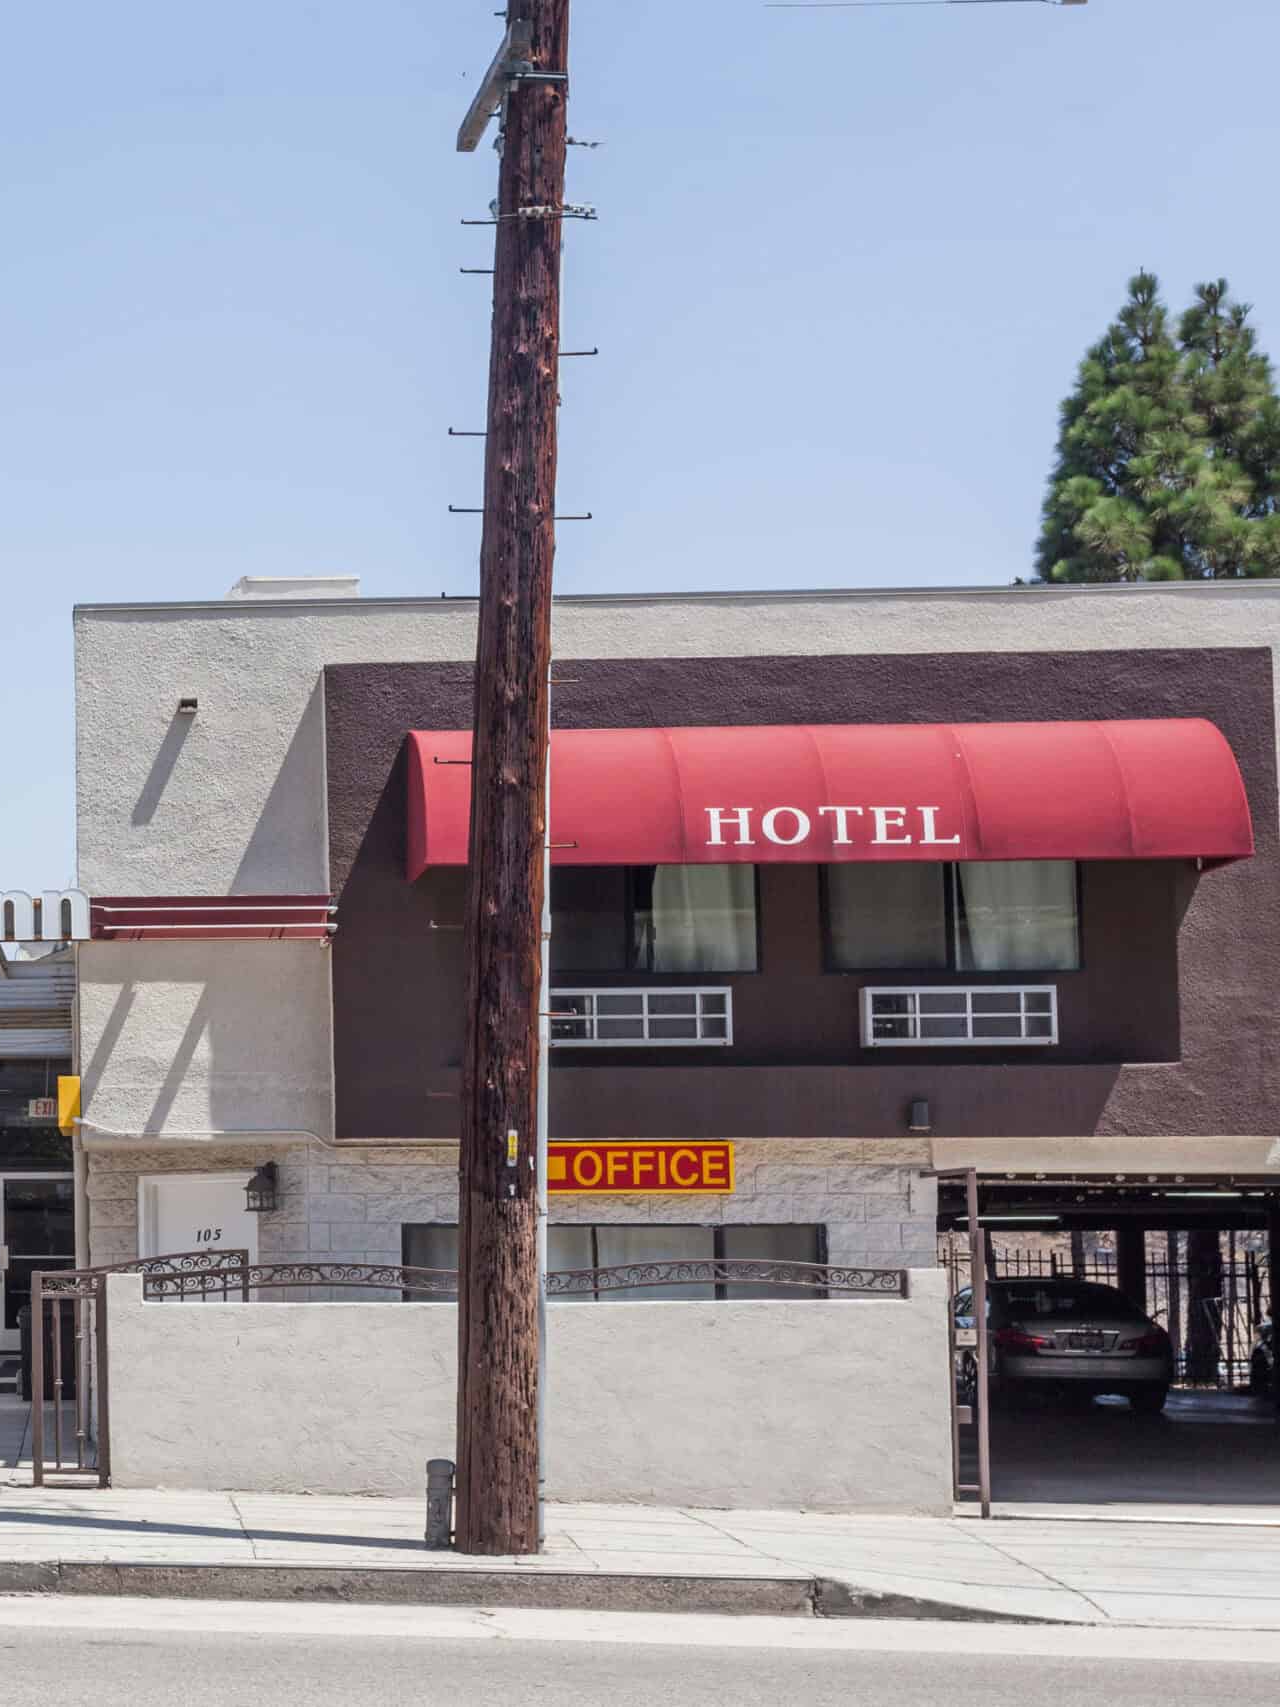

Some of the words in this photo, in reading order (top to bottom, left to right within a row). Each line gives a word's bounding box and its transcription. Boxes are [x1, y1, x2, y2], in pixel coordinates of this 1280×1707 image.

[704, 806, 960, 845] HOTEL
[573, 1149, 726, 1186] OFFICE
[196, 1228, 222, 1242] 105
